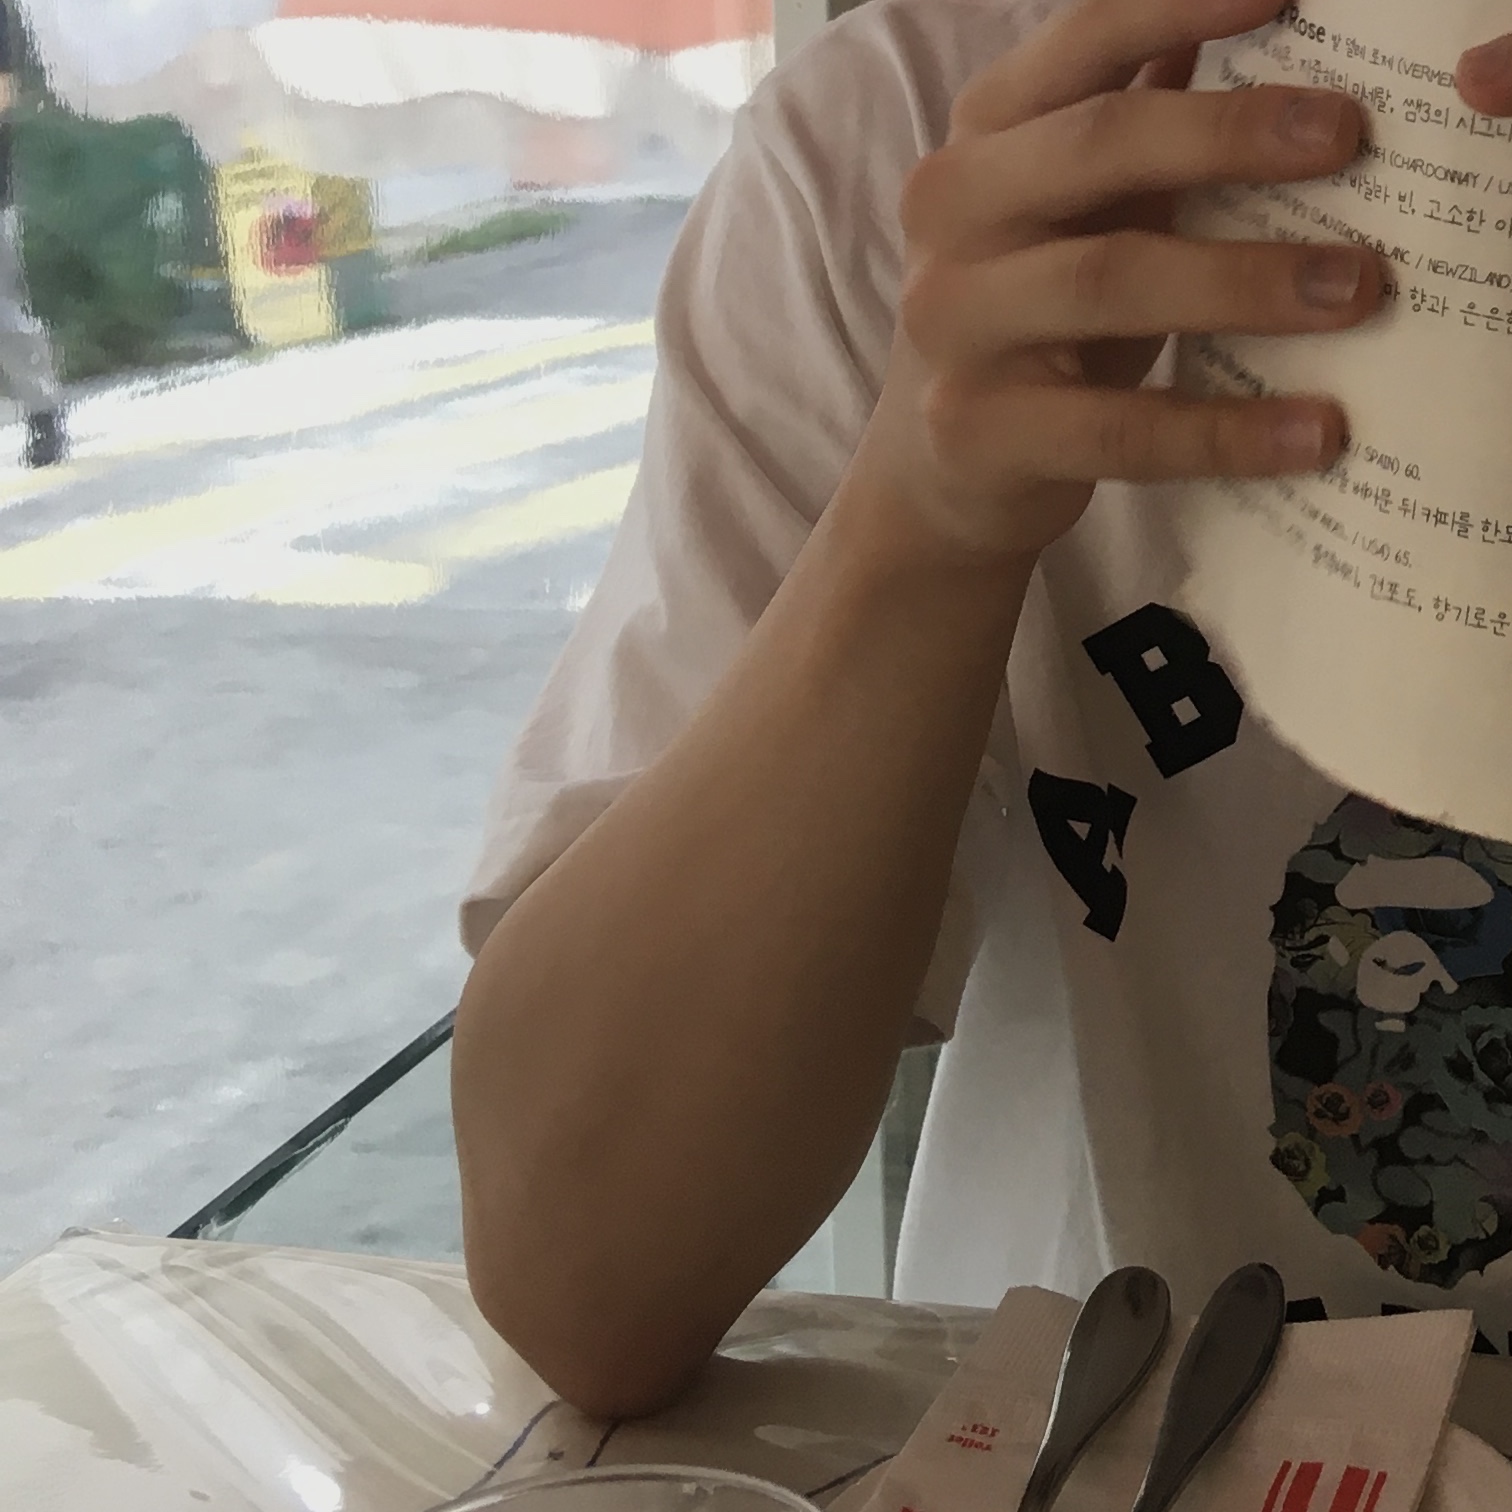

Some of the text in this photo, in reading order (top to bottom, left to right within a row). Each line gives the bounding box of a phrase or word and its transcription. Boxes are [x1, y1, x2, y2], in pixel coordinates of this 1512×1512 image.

[1390, 150, 1480, 189] (CHARDONNAY
[1349, 174, 1391, 205] 바닐라
[1424, 200, 1486, 234] 고소한
[1410, 286, 1450, 317] 향과
[1365, 445, 1400, 476] SPAIN)
[1405, 463, 1421, 481] 60.
[1398, 497, 1417, 521] 뒤
[1421, 506, 1474, 539] 커피를
[1394, 550, 1413, 568] 65.
[1369, 573, 1423, 613] 건포도,
[1433, 596, 1511, 637] 향기로운
